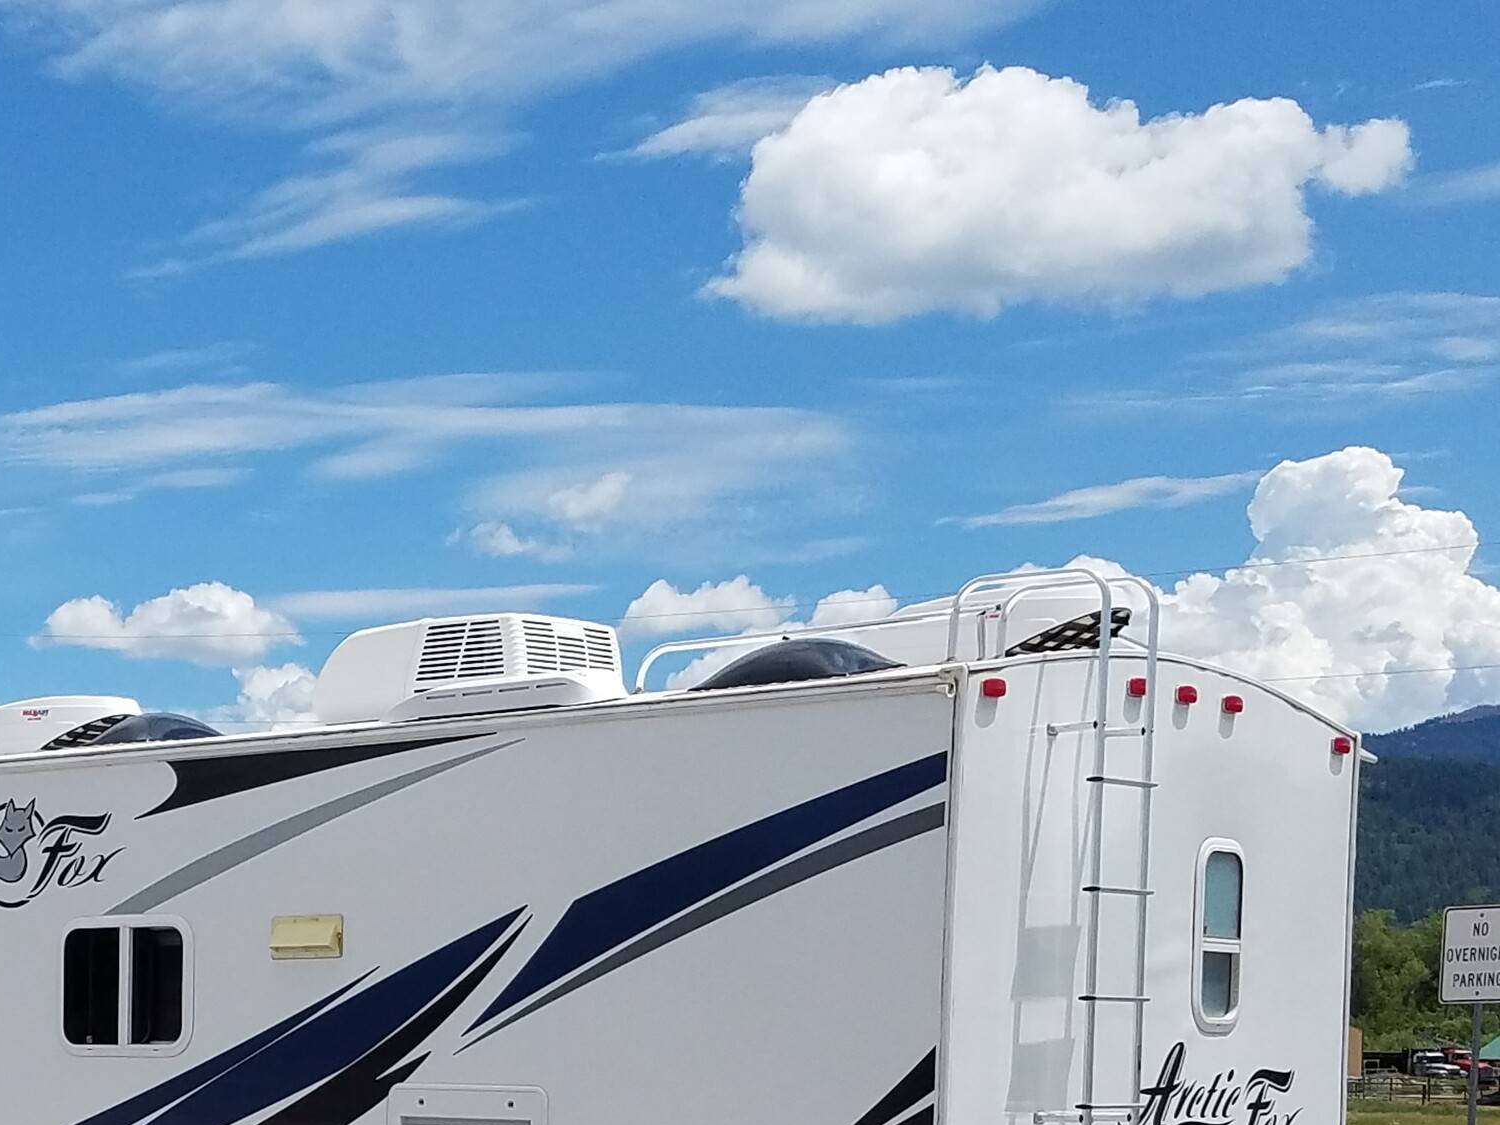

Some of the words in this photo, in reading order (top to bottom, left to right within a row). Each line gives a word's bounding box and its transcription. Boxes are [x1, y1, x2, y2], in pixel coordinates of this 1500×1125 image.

[27, 811, 127, 899] Fox
[1473, 922, 1489, 937] NO
[1446, 946, 1500, 963] OVERNIG
